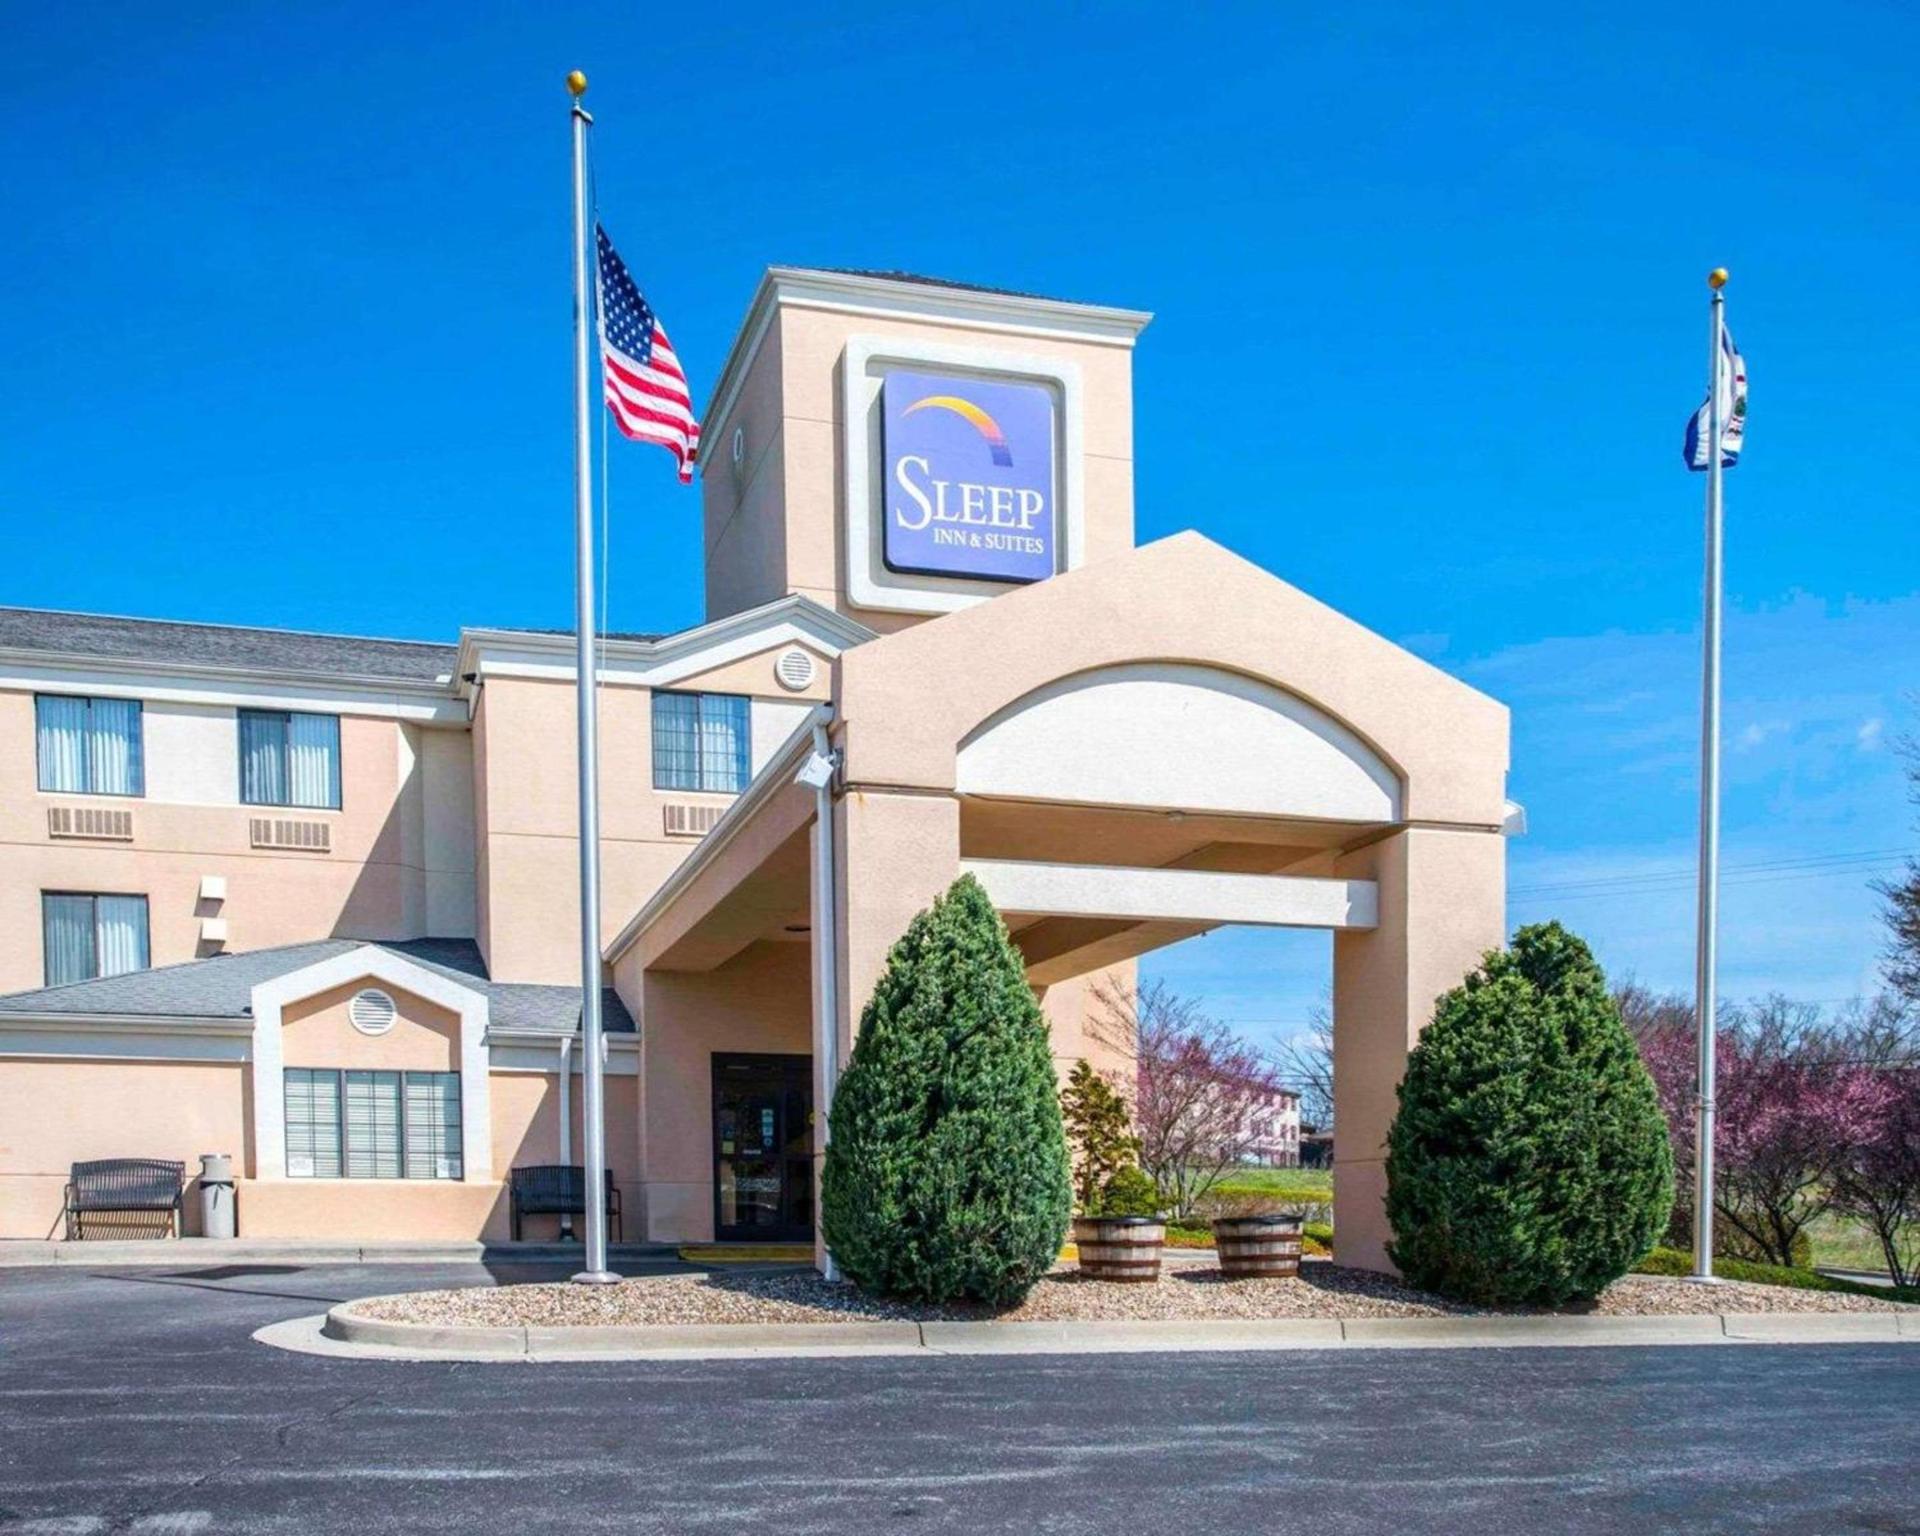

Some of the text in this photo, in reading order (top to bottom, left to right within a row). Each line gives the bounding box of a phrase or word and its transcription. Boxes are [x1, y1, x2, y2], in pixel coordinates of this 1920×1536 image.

[896, 455, 1044, 530] SLEEP
[934, 528, 1044, 554] INN & SUITES
